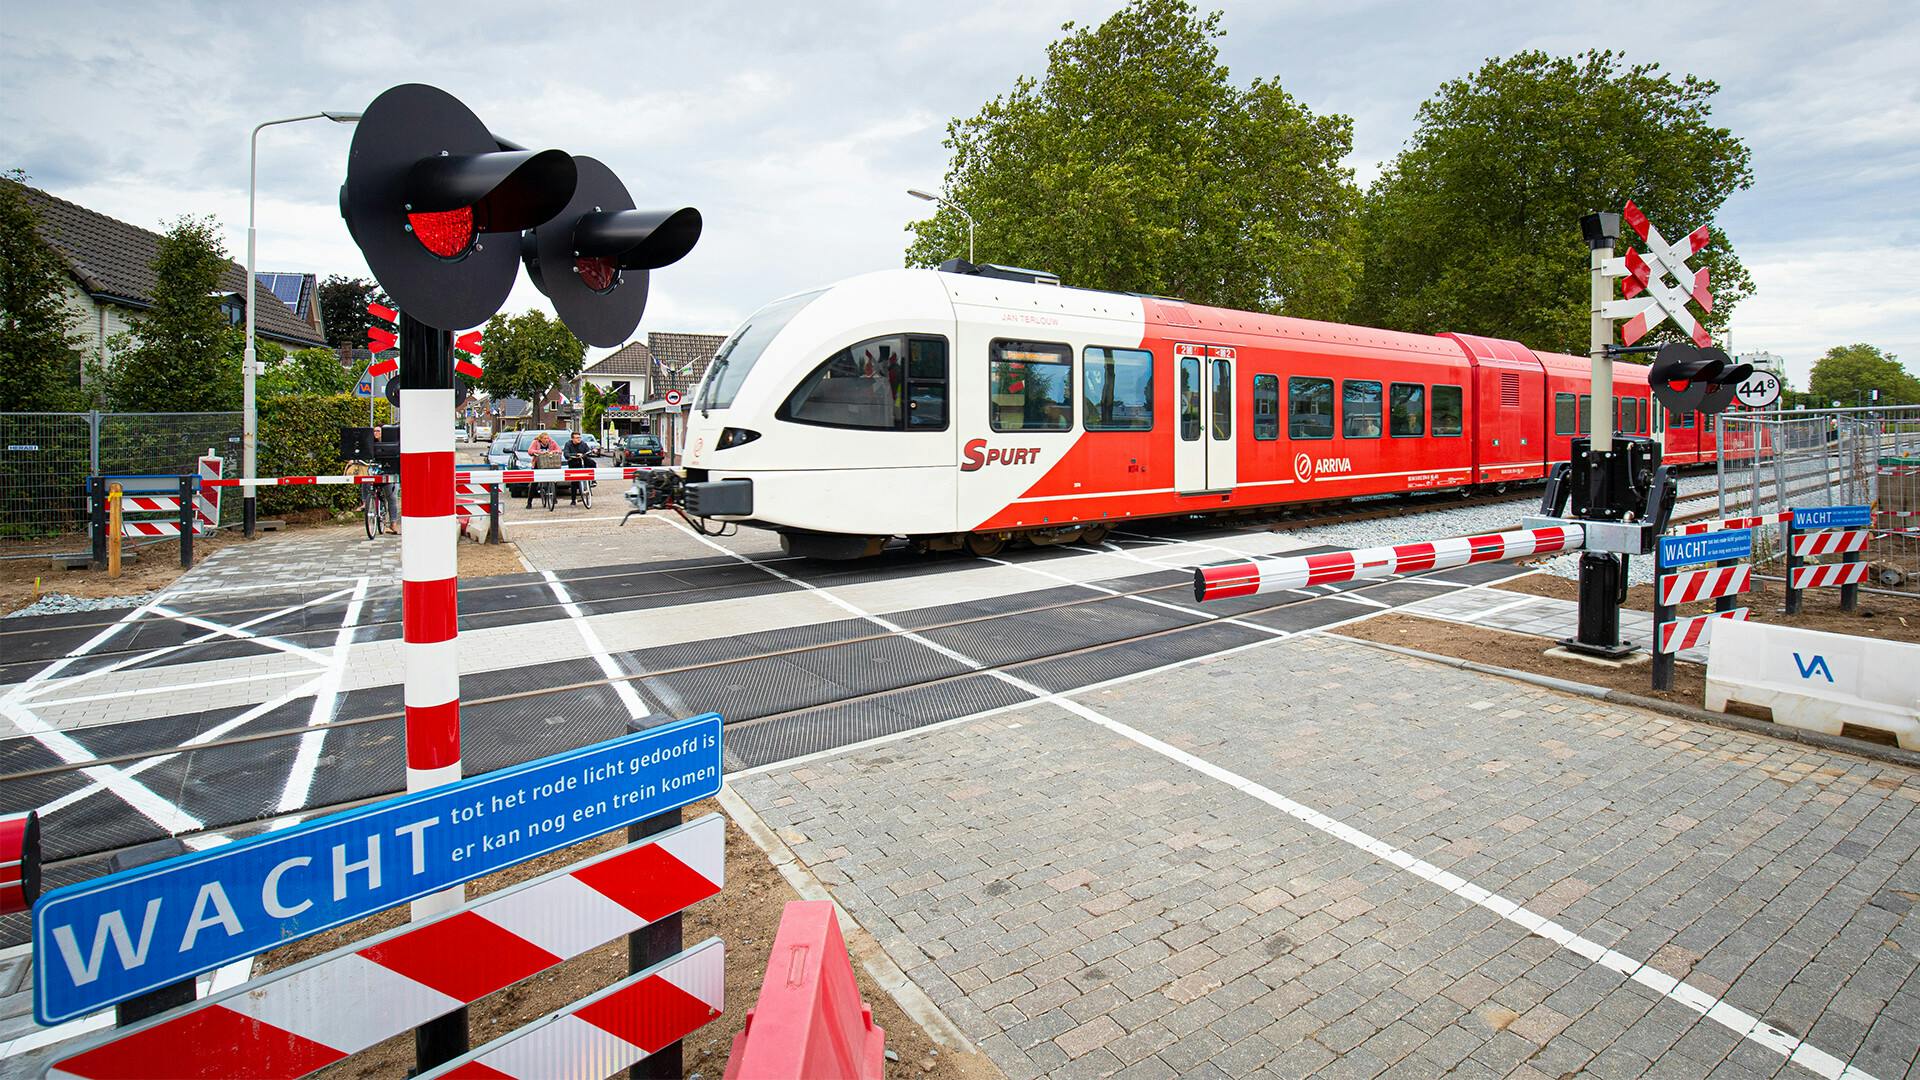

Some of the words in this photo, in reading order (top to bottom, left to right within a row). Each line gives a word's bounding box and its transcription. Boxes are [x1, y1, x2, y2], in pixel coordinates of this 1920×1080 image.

[960, 438, 1041, 472] SPURT
[1314, 457, 1352, 474] ARRIVA
[1796, 511, 1832, 525] WACHT
[1665, 540, 1708, 561] WACHT
[450, 801, 484, 825] tot
[491, 789, 526, 813] het
[533, 776, 577, 801] rode
[583, 760, 625, 786] licht
[630, 737, 698, 773] gedoofd
[702, 733, 715, 748] is
[451, 846, 475, 862] er
[483, 828, 520, 853] kan
[528, 813, 566, 839] nog
[572, 800, 607, 822] een
[613, 784, 656, 809] trein
[662, 764, 716, 793] komen
[52, 816, 440, 987] WACHT
